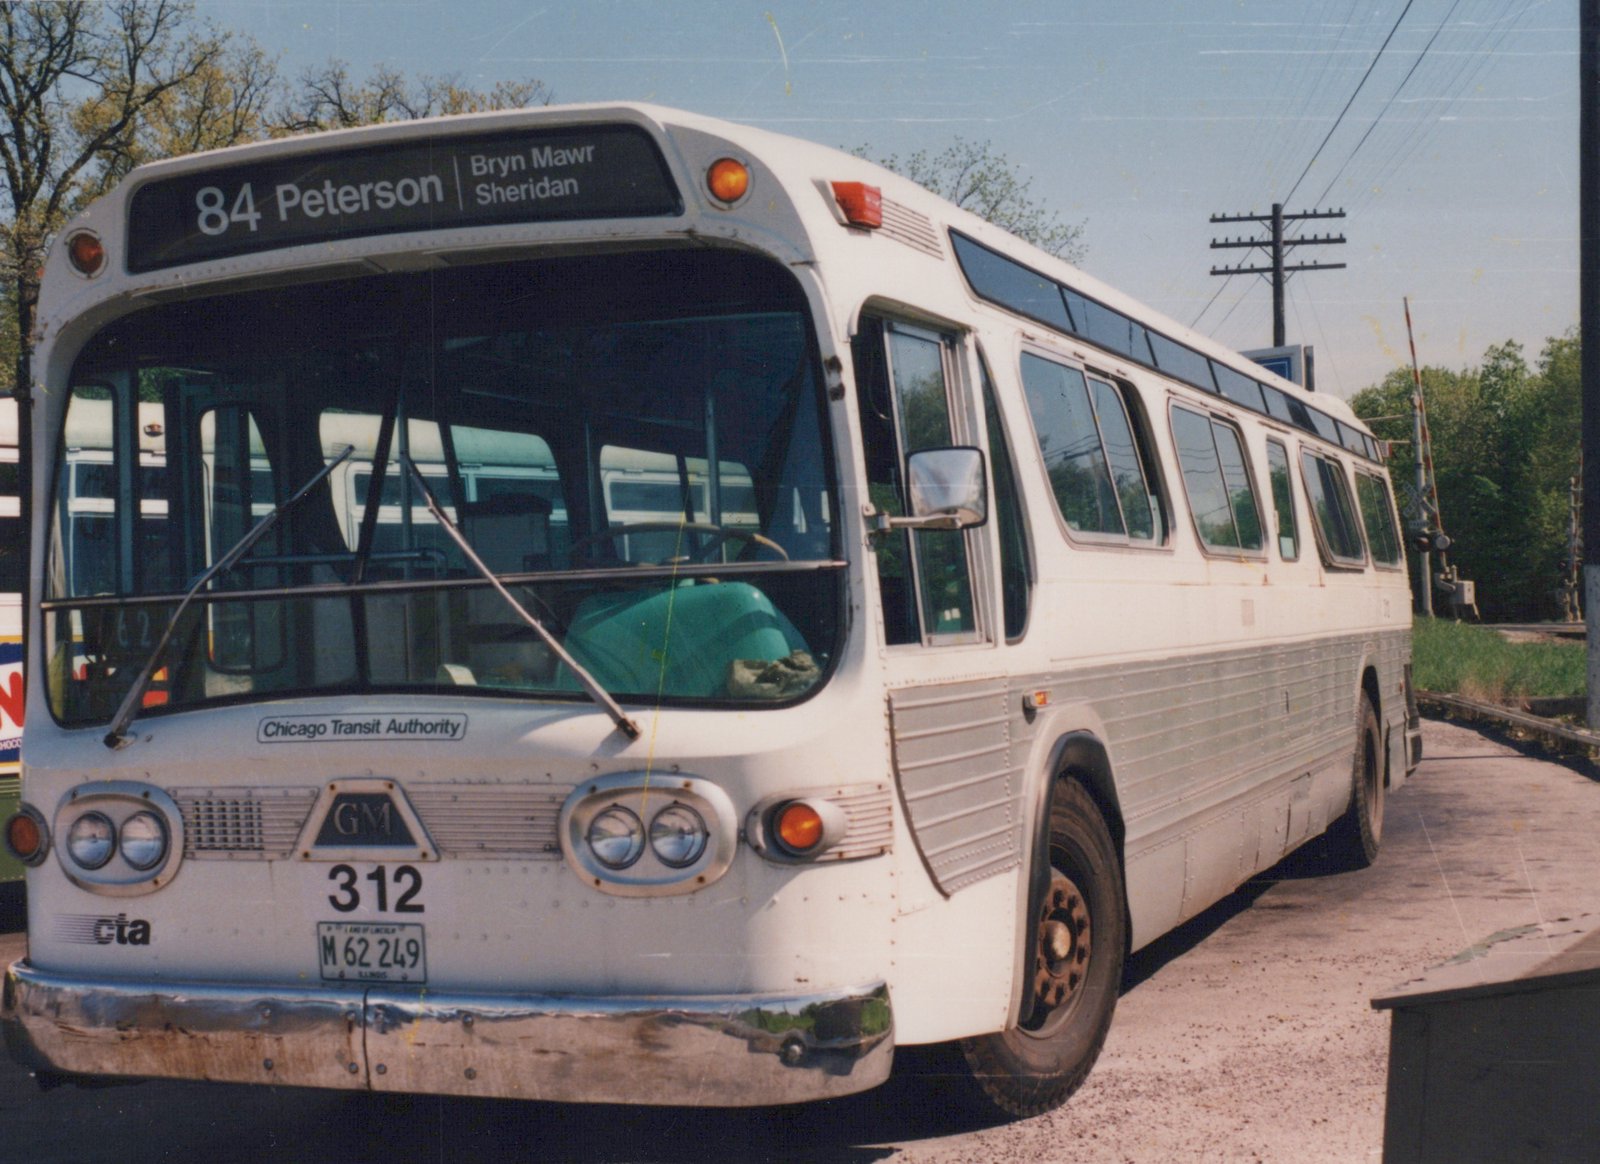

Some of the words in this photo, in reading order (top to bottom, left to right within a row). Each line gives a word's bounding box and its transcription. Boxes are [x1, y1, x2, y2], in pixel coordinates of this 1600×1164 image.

[470, 154, 526, 178] Bryn
[531, 145, 595, 169] Mawr
[196, 182, 262, 235] 84
[275, 174, 444, 222] Peterson
[475, 176, 579, 205] Sheridan
[263, 721, 327, 740] Chicago
[331, 719, 381, 735] Transit
[386, 718, 460, 736] Authority
[333, 802, 392, 836] GM
[328, 864, 425, 913] 312
[94, 913, 151, 946] cta
[322, 935, 337, 966] M
[344, 936, 371, 967] 62
[378, 937, 420, 969] 249
